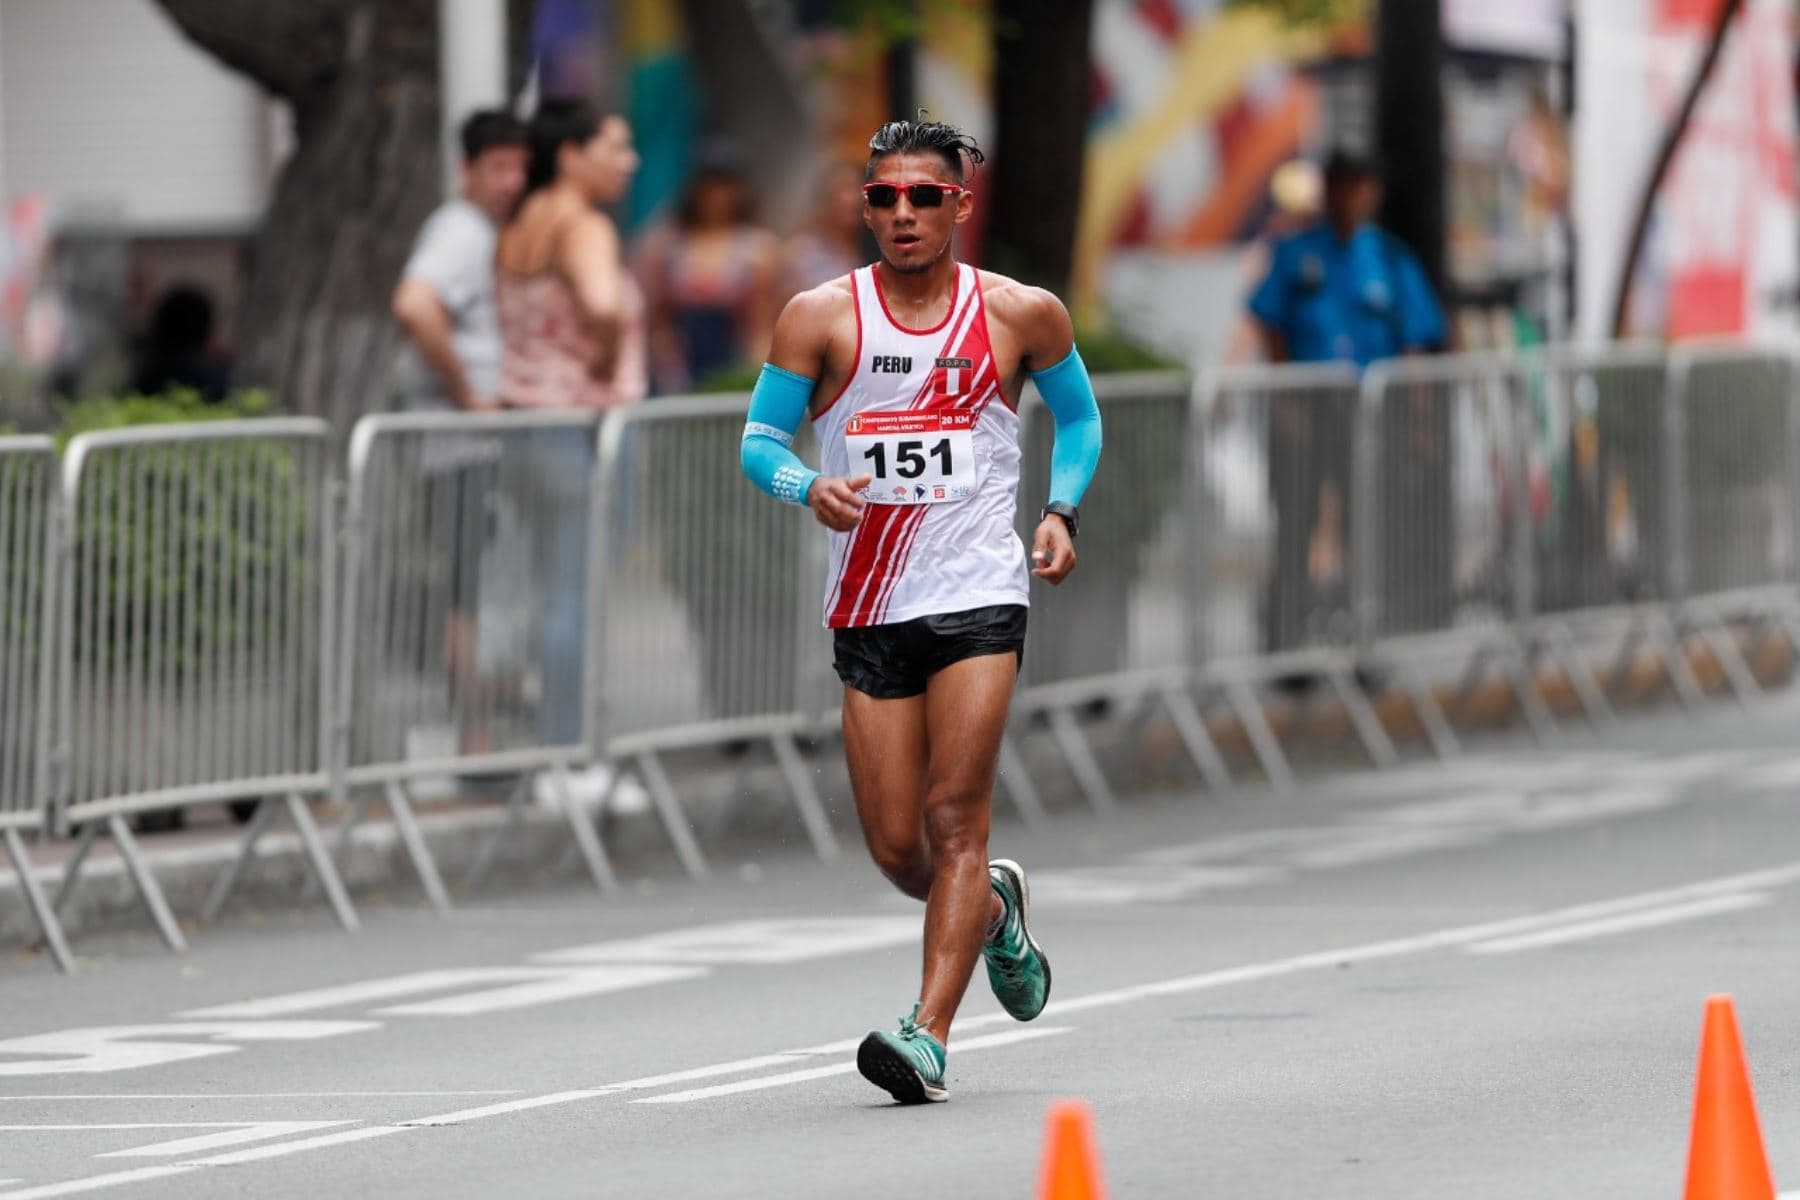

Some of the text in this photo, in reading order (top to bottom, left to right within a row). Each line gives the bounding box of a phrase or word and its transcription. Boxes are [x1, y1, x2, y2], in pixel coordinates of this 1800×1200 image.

[872, 355, 912, 374] PERU
[941, 414, 970, 425] 20 KM
[864, 438, 953, 479] 151
